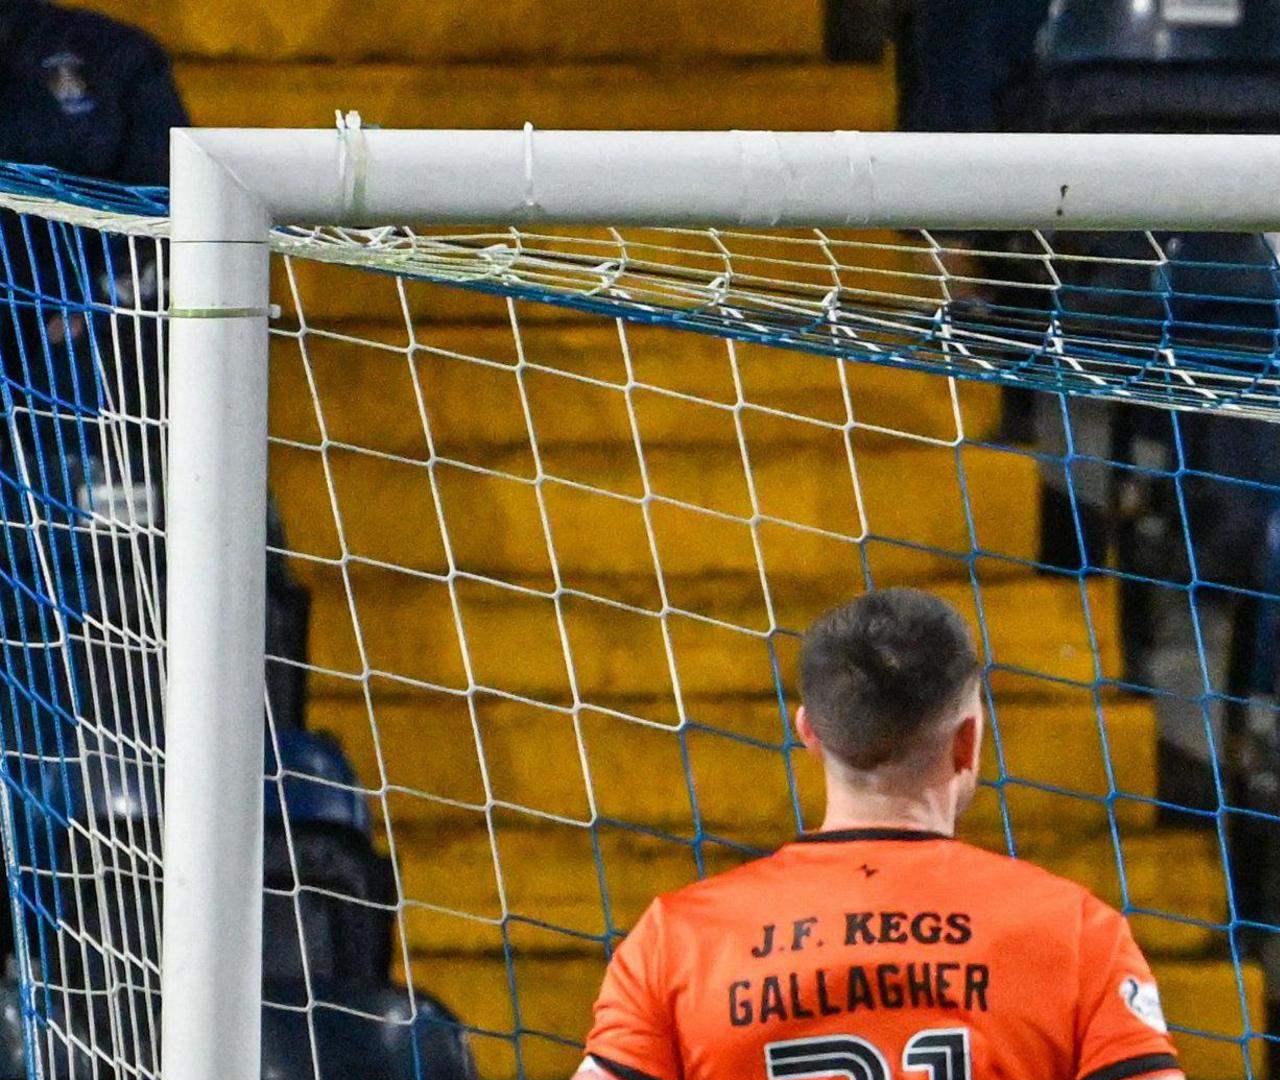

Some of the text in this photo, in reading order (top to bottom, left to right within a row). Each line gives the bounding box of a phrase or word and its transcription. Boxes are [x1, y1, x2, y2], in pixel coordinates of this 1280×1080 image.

[751, 911, 972, 958] J.F. KEGS
[728, 963, 990, 1027] GALLAGHER
